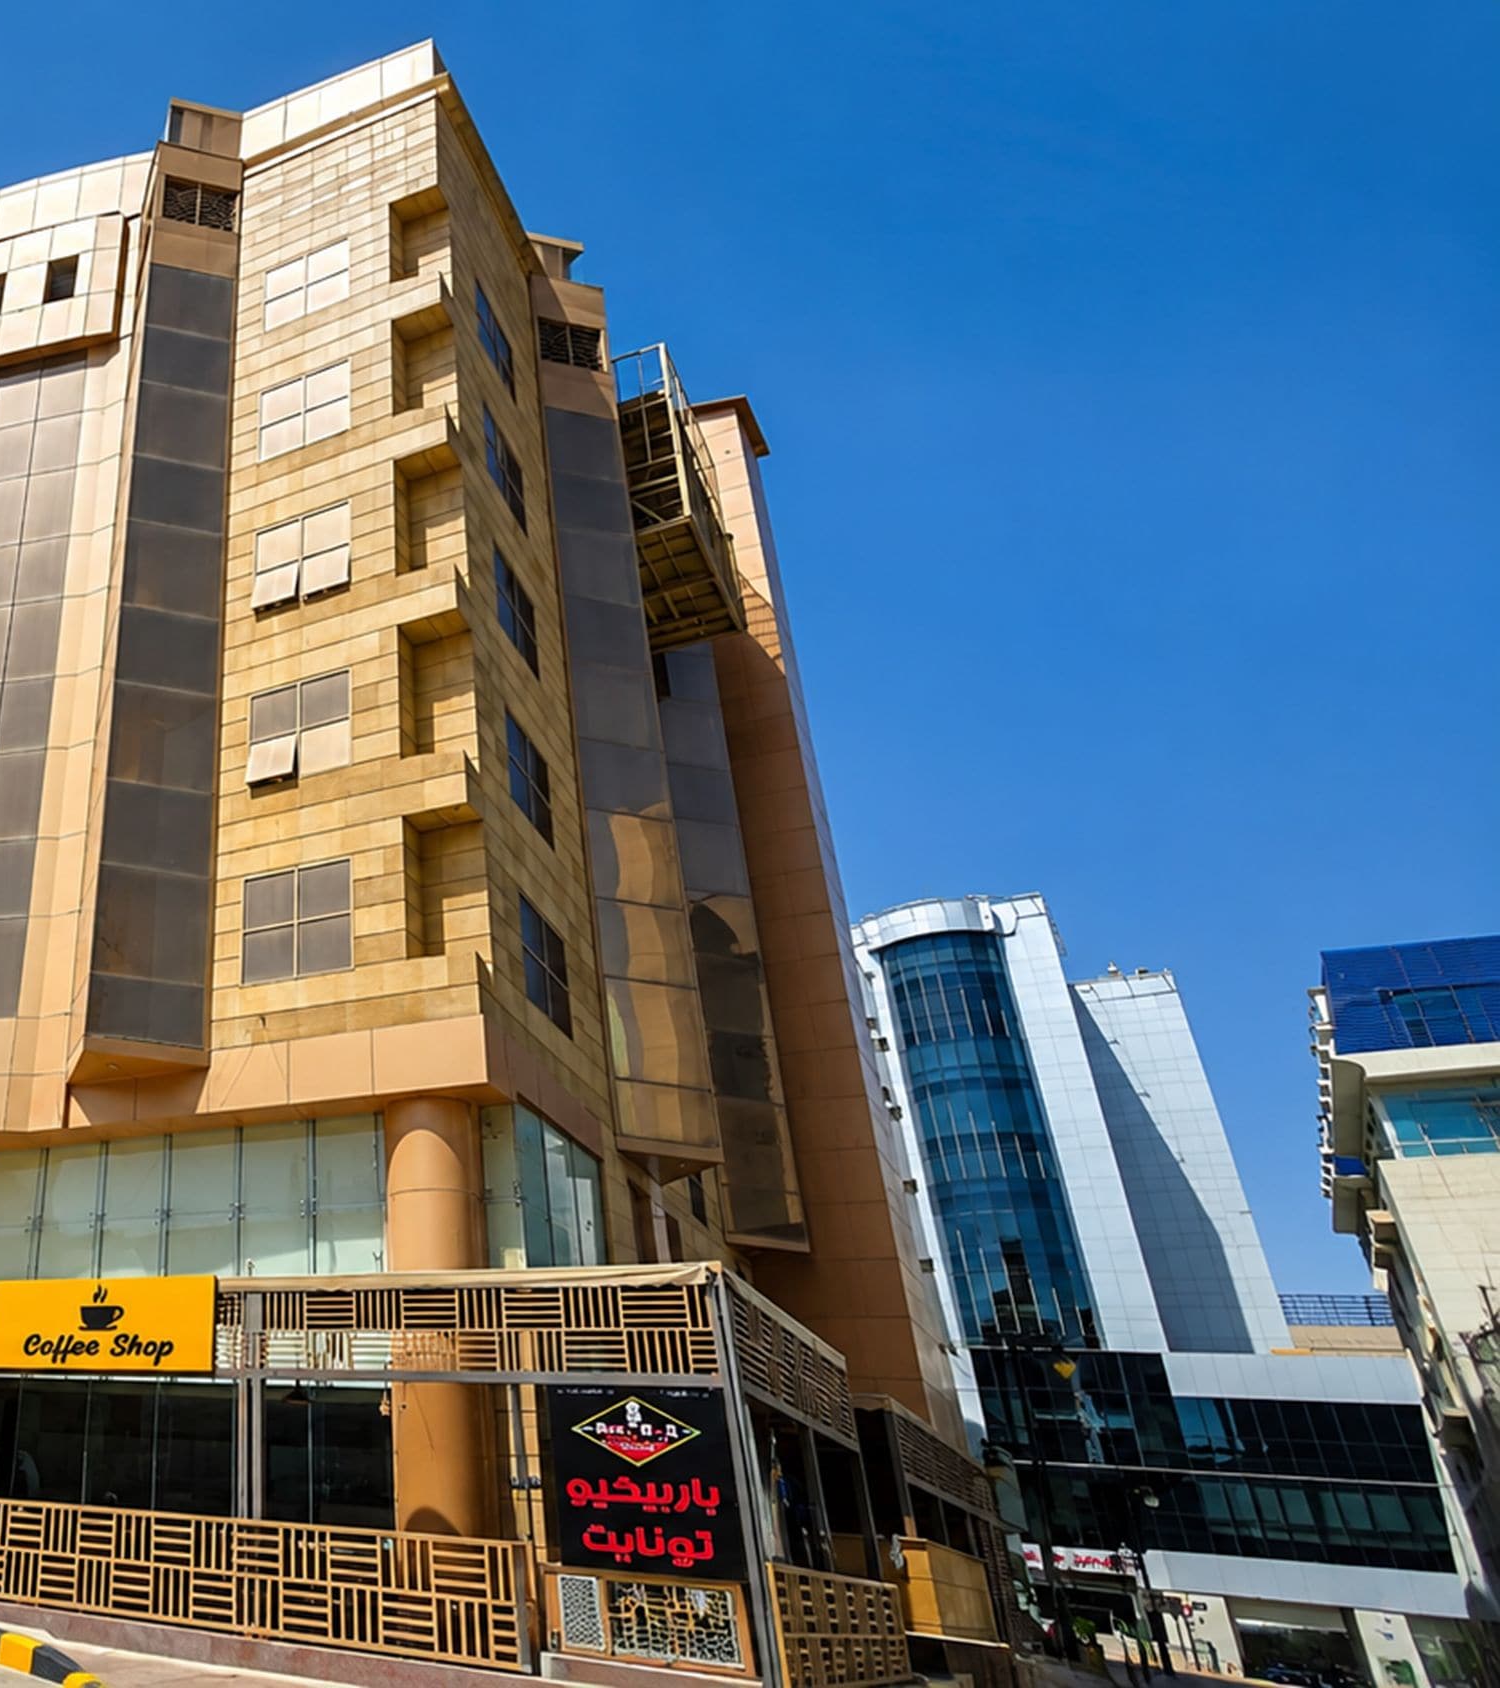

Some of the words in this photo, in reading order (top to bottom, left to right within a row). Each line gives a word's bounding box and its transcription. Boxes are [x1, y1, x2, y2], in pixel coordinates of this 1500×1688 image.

[23, 1333, 100, 1364] Coffee
[109, 1333, 175, 1367] Shop
[566, 1475, 720, 1516] باربيكيو
[582, 1523, 715, 1567] تونايت
